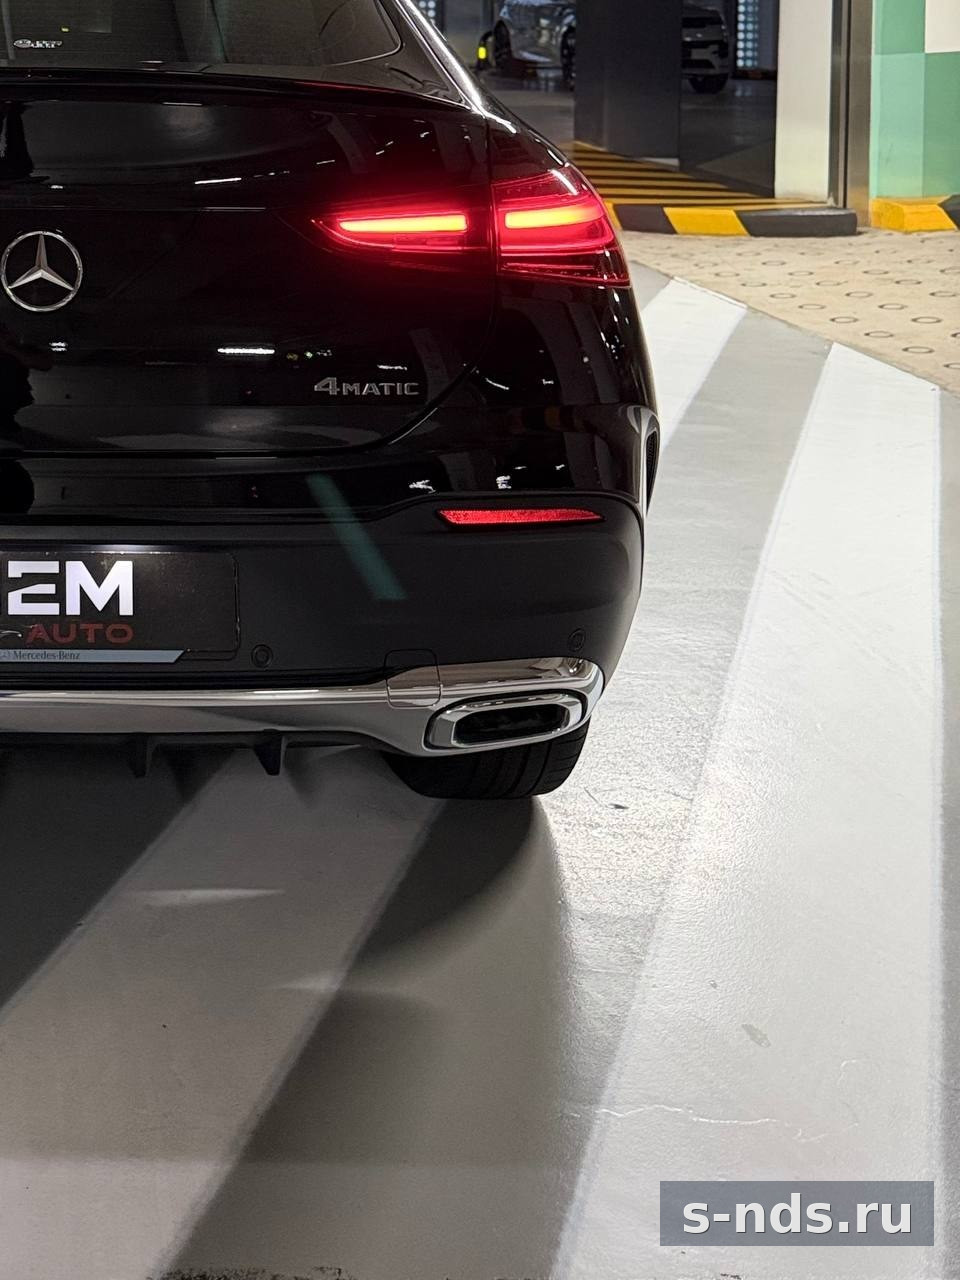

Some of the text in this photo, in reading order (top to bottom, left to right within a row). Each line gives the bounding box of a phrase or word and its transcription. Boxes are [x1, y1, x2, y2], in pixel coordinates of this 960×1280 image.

[314, 377, 420, 395] 4MATIC
[25, 623, 134, 644] AUTO
[13, 650, 81, 661] Mercedes-Benz
